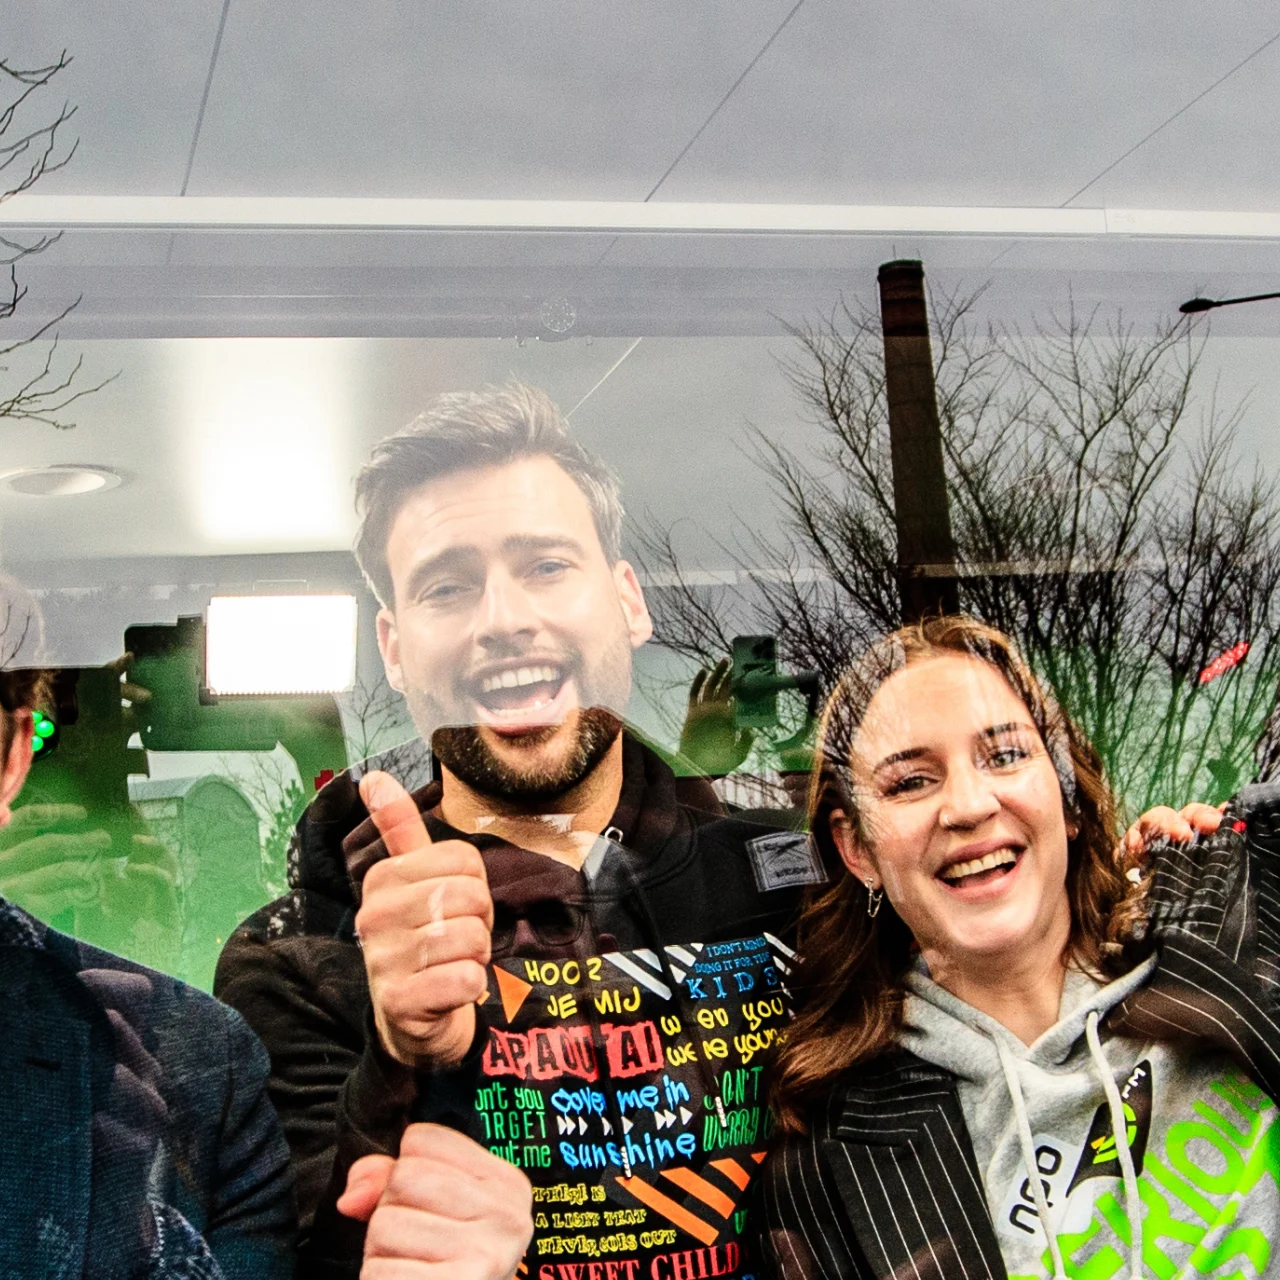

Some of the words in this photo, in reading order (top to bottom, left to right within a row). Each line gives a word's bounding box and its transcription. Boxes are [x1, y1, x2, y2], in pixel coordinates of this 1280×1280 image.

[712, 943, 741, 956] DON'T
[723, 960, 734, 971] IT
[686, 966, 778, 999] KIDS
[547, 993, 578, 1019] JE
[616, 1085, 660, 1115] me
[662, 1074, 690, 1112] in
[524, 1145, 551, 1167] me
[591, 1185, 607, 1202] IS
[535, 1213, 549, 1228] A
[552, 1211, 601, 1229] LIGHT
[604, 1209, 647, 1226] THAT
[640, 1230, 677, 1248] OUT
